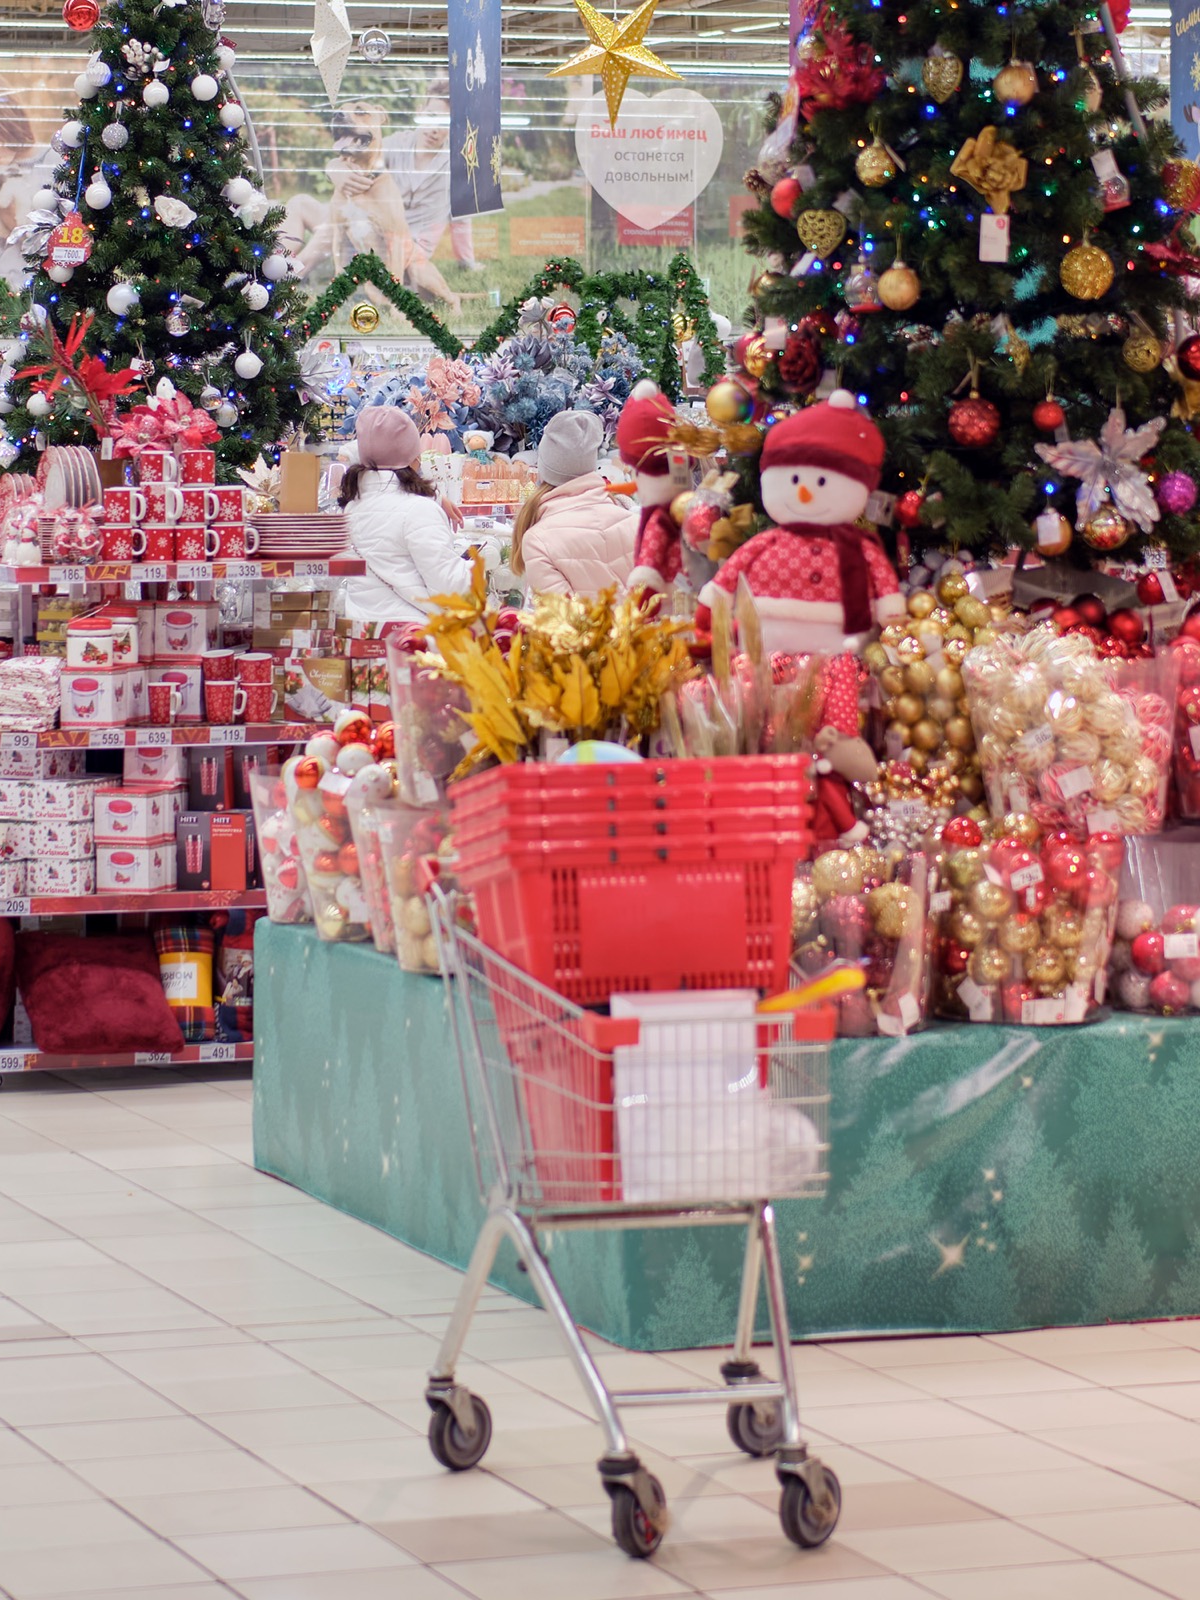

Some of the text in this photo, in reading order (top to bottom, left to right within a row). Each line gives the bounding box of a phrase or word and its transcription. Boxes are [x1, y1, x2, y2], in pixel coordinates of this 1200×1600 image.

[591, 124, 707, 143] Ваш любимец
[614, 151, 684, 162] останется
[604, 169, 694, 184] довольным!
[59, 227, 83, 244] 18
[376, 345, 439, 355] Влажный кор
[62, 568, 80, 580] 186
[144, 567, 161, 578] 119
[190, 566, 207, 577] 119
[238, 565, 256, 576] 339
[306, 563, 324, 575] 339
[13, 734, 30, 746] 99
[102, 733, 120, 744] 559
[148, 732, 166, 743] 639
[222, 729, 240, 740] 119
[2, 769, 35, 777] Christmas
[35, 810, 67, 818] Christmas
[36, 848, 70, 857] Christmas
[36, 885, 70, 894] Christmas
[6, 901, 25, 912] 209
[212, 1047, 230, 1059] 491
[1, 1057, 19, 1069] 599
